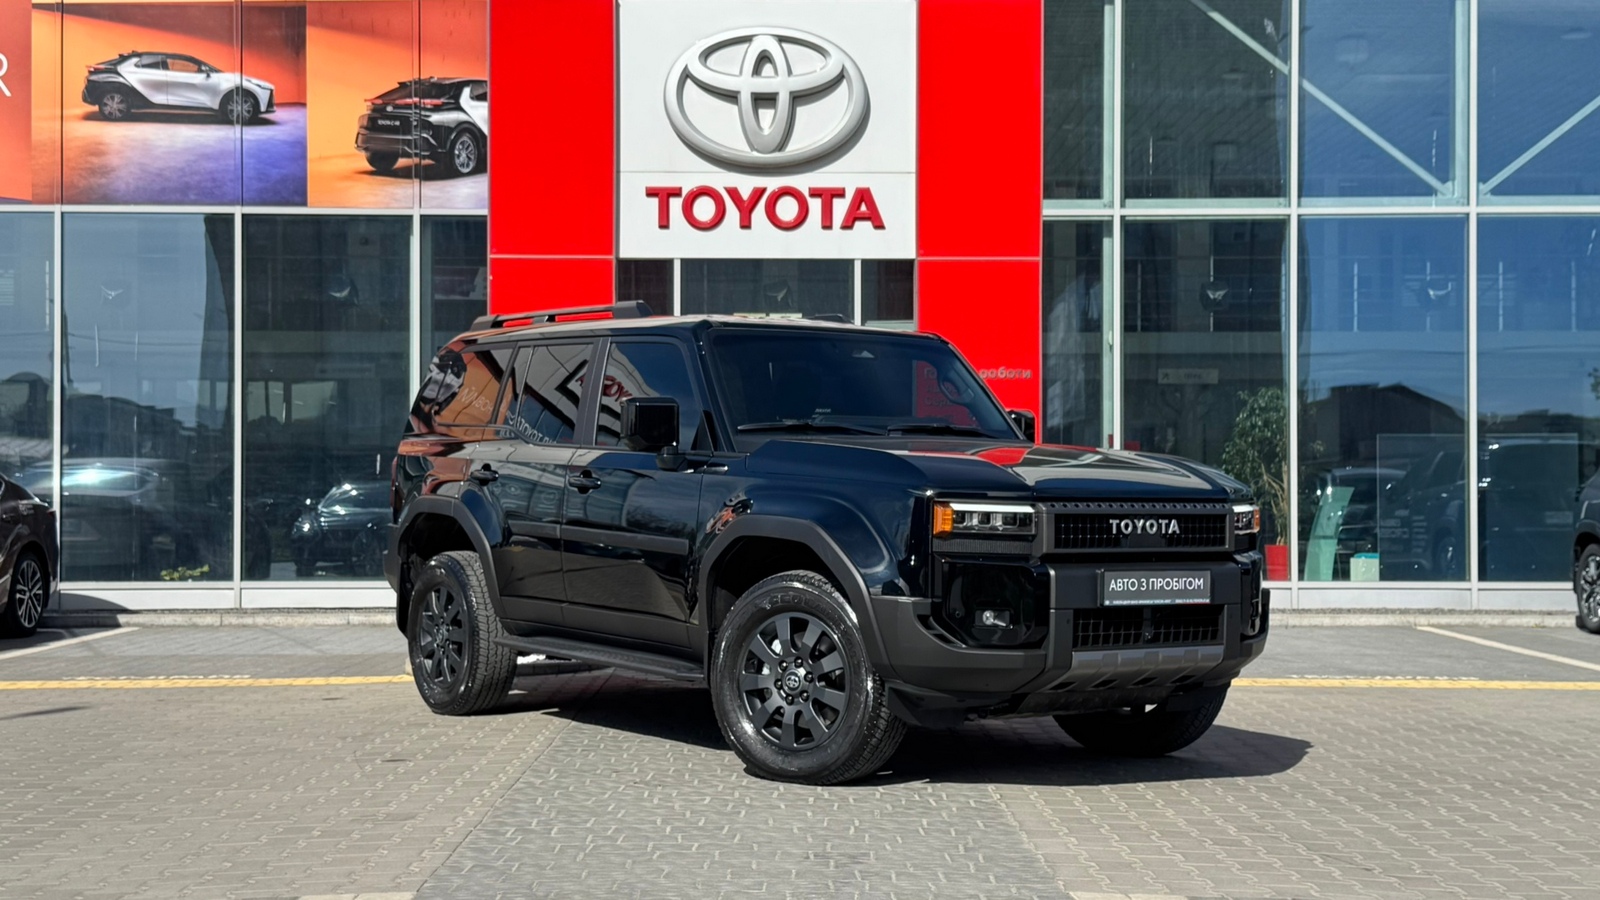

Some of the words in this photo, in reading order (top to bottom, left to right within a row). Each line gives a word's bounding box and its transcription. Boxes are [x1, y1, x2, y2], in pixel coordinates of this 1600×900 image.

[645, 185, 886, 232] TOYOTA
[1109, 519, 1180, 534] TOYOTA
[1109, 578, 1138, 592] АВТО
[1149, 577, 1204, 591] ПРОБІГОМ
